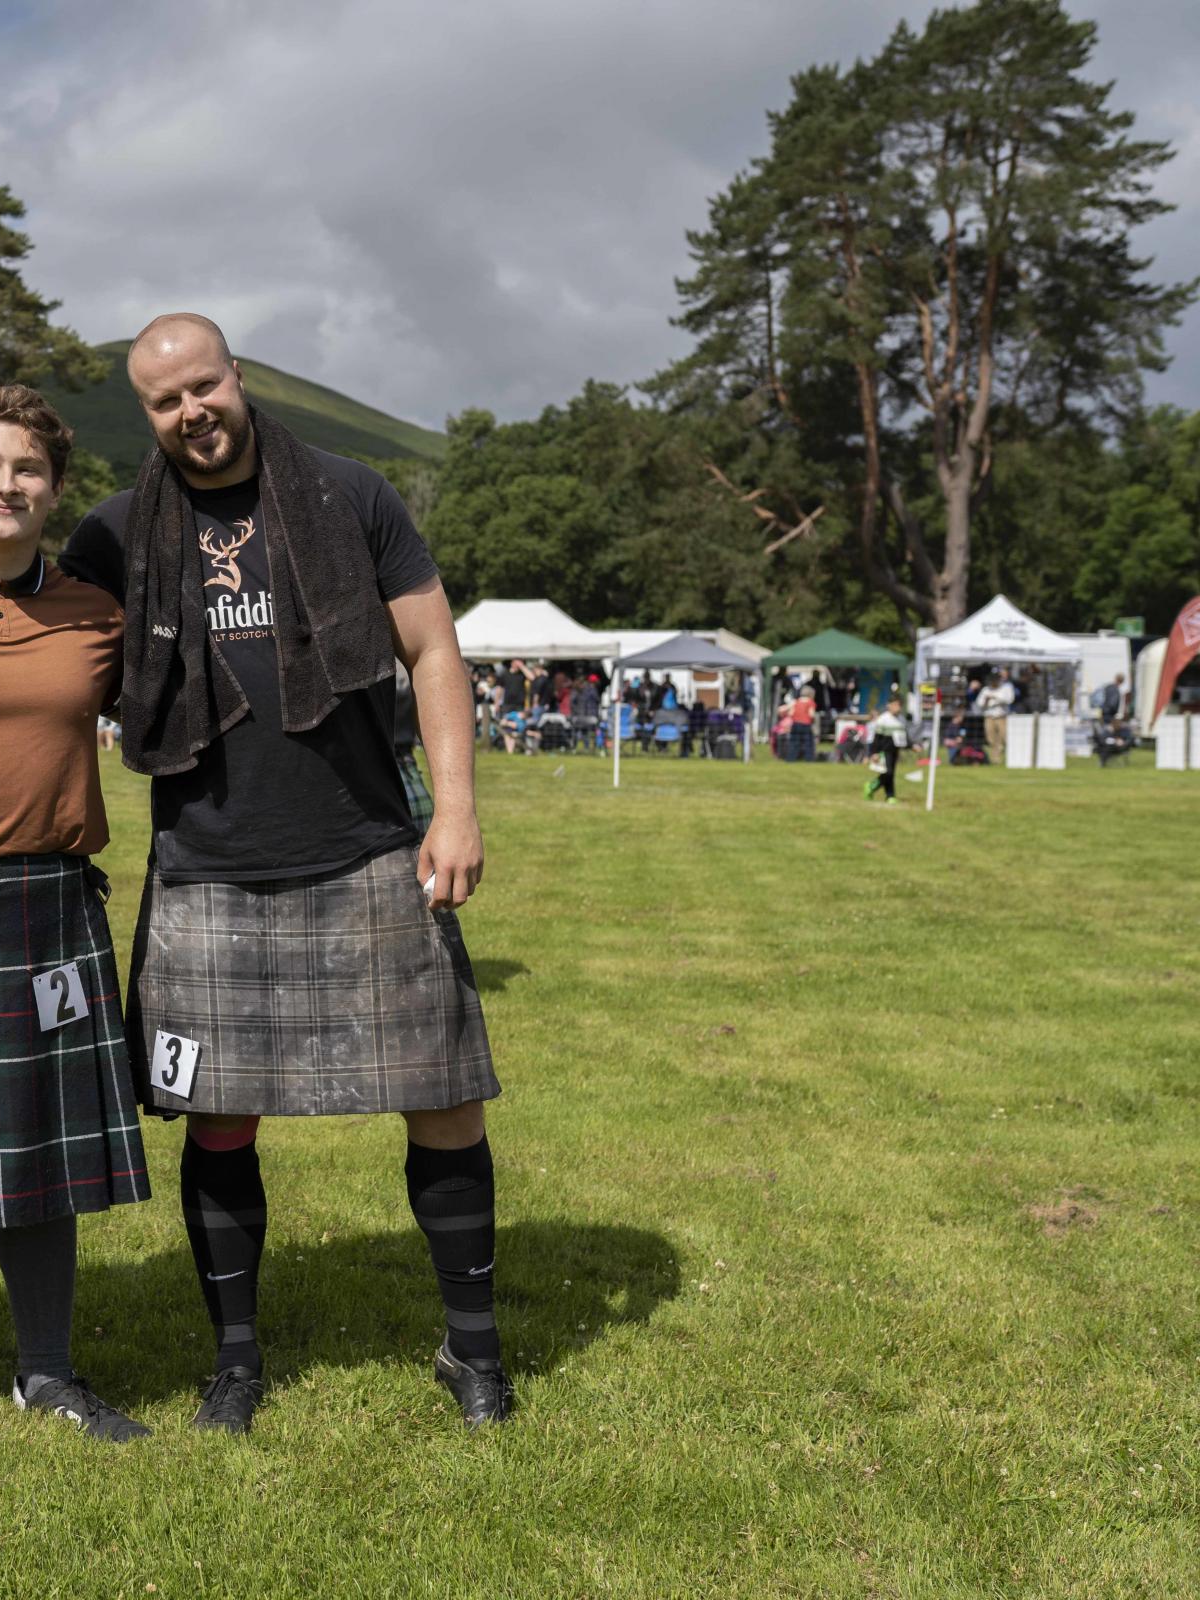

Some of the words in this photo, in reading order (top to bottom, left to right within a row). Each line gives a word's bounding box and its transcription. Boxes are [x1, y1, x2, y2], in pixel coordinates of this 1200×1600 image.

[228, 630, 268, 641] SCOTCH
[50, 970, 77, 1024] 2
[162, 1037, 182, 1087] 3
